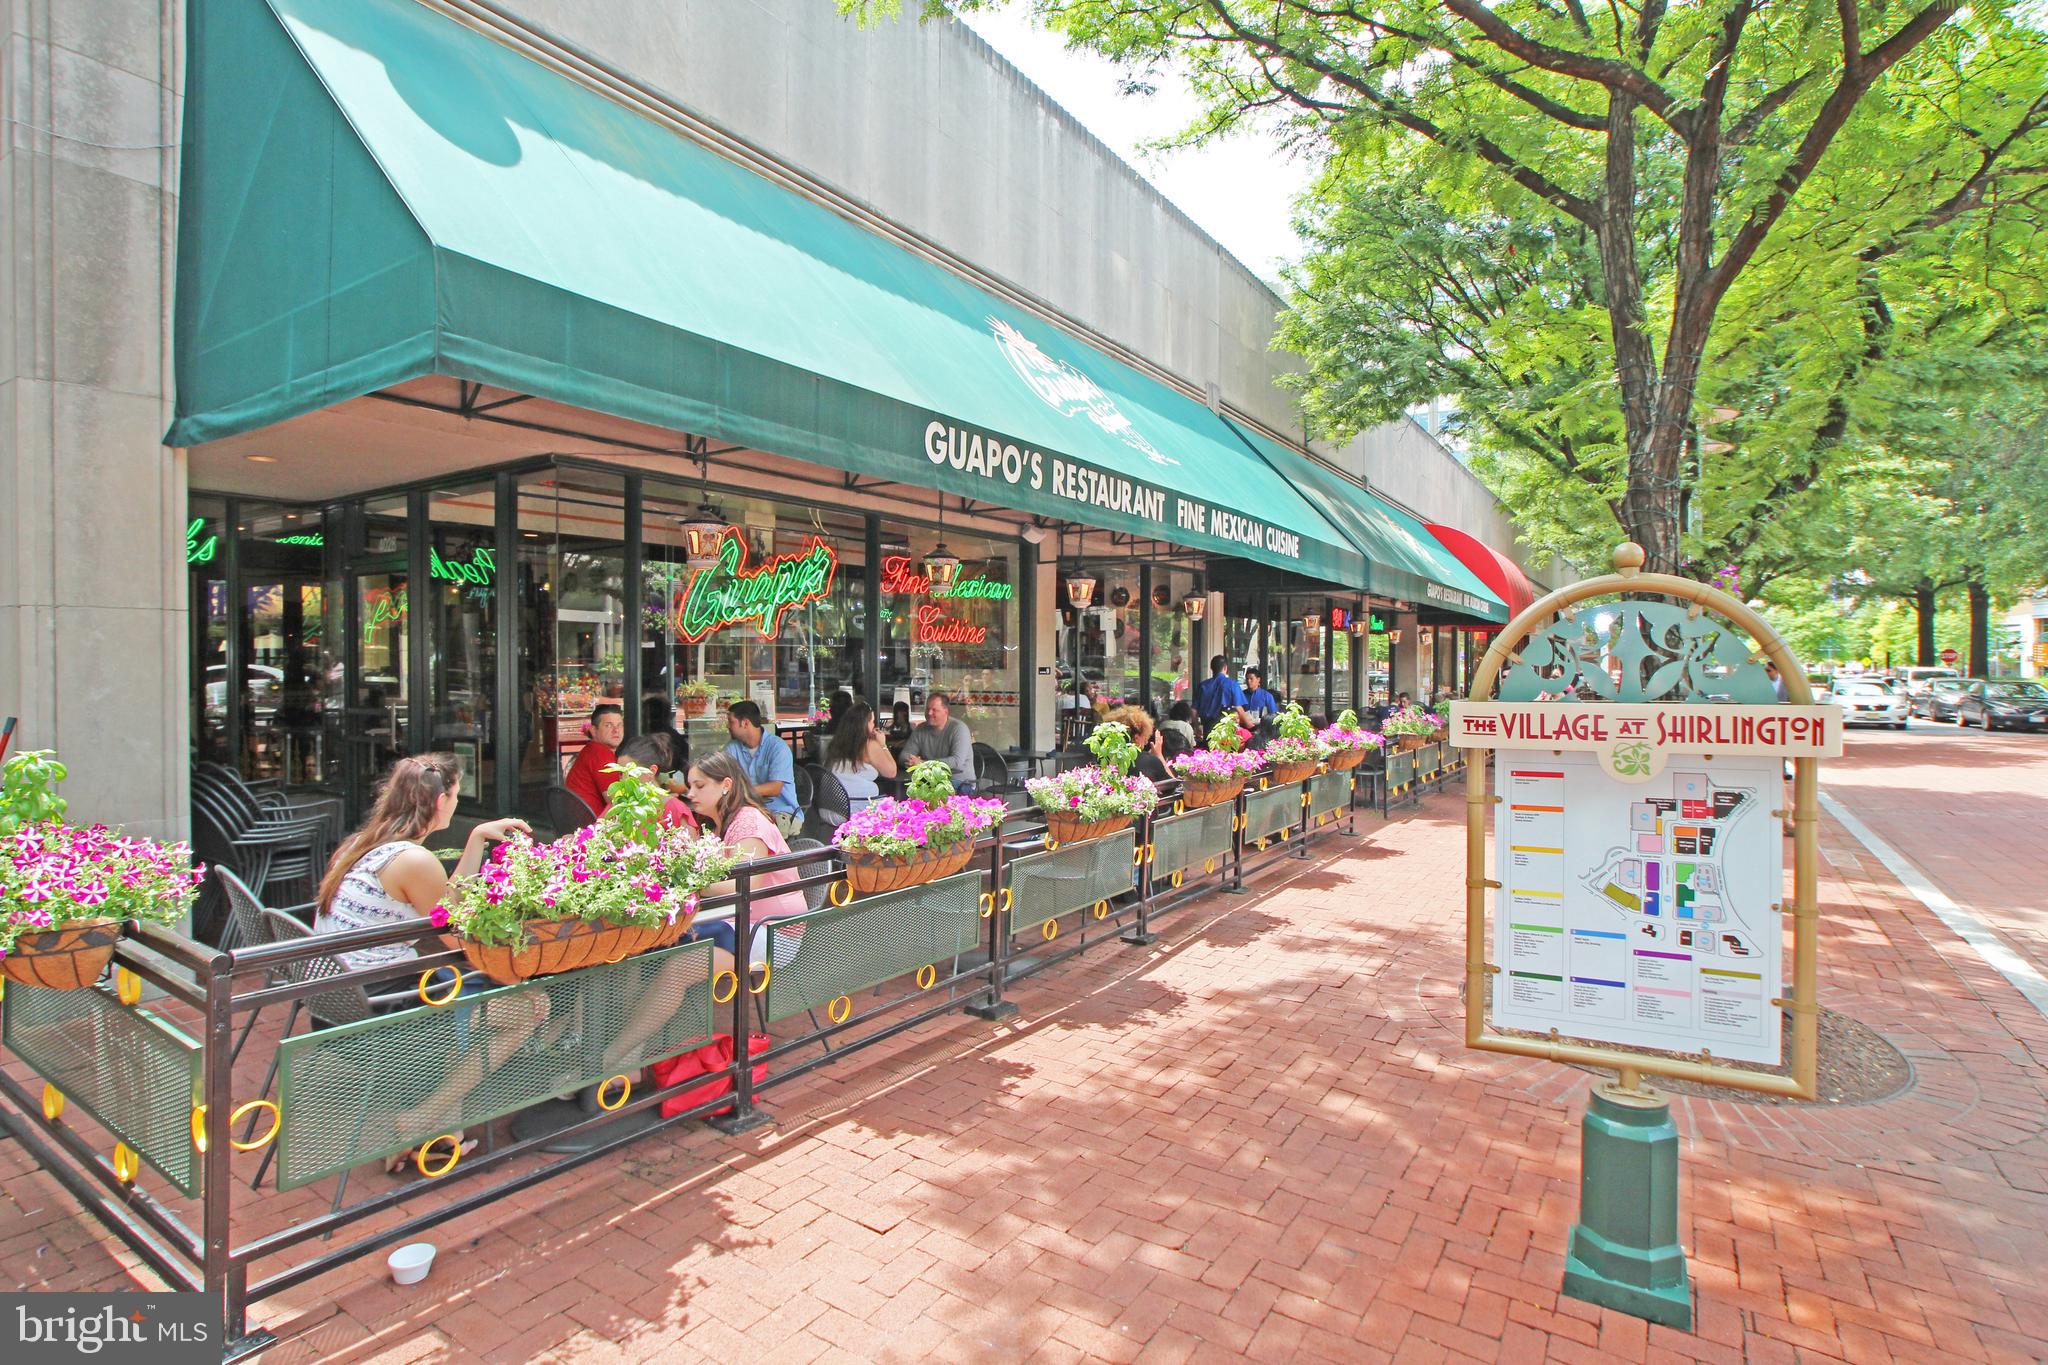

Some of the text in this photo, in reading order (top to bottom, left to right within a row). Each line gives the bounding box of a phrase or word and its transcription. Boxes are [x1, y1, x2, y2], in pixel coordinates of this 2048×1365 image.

[924, 420, 1300, 559] GUAPO'S RESTAURANT FINE MEXICAN CUISINE
[881, 555, 931, 594] Fine
[918, 604, 986, 644] Cuisine
[1463, 711, 1825, 747] THE VILLAGE AT SHIRLINGTON
